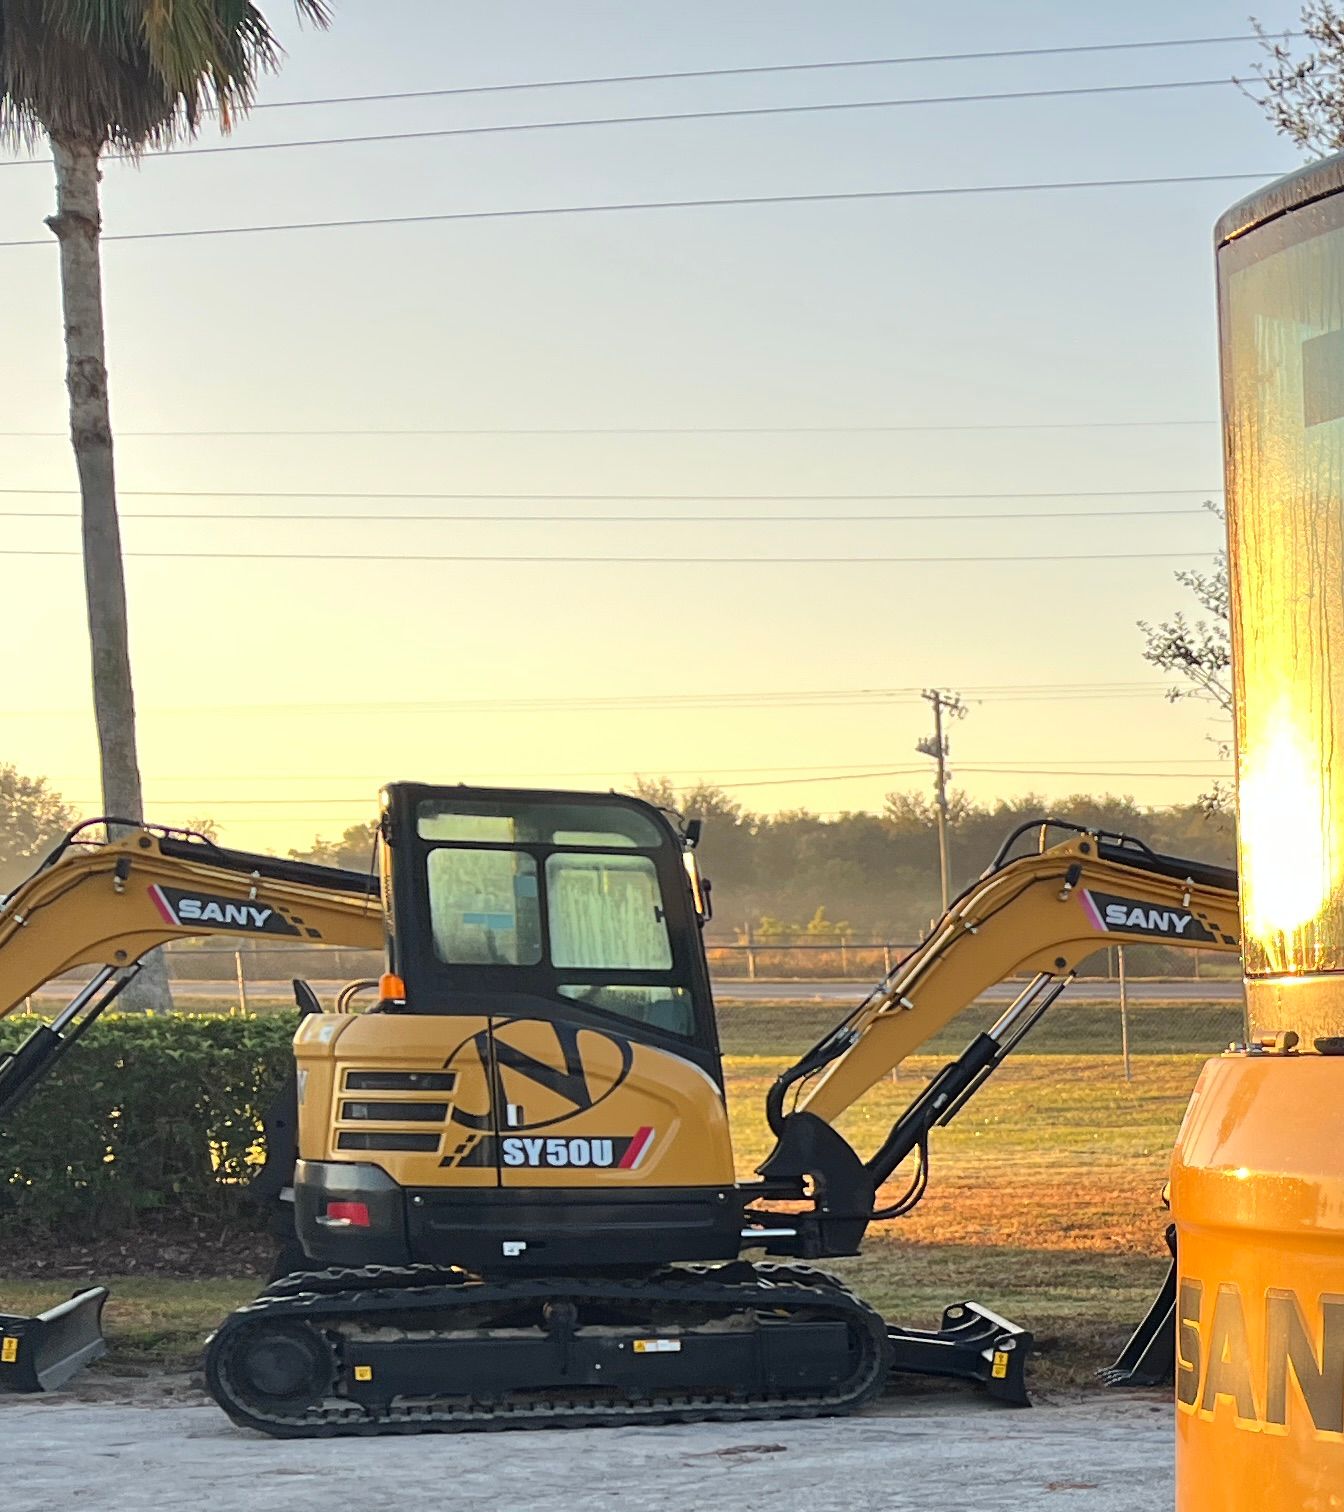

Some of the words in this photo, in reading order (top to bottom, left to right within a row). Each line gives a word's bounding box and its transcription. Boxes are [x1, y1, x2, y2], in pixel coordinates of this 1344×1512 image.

[178, 899, 272, 928] SANY
[1105, 904, 1192, 933] SANY
[502, 1137, 613, 1167] SY50U
